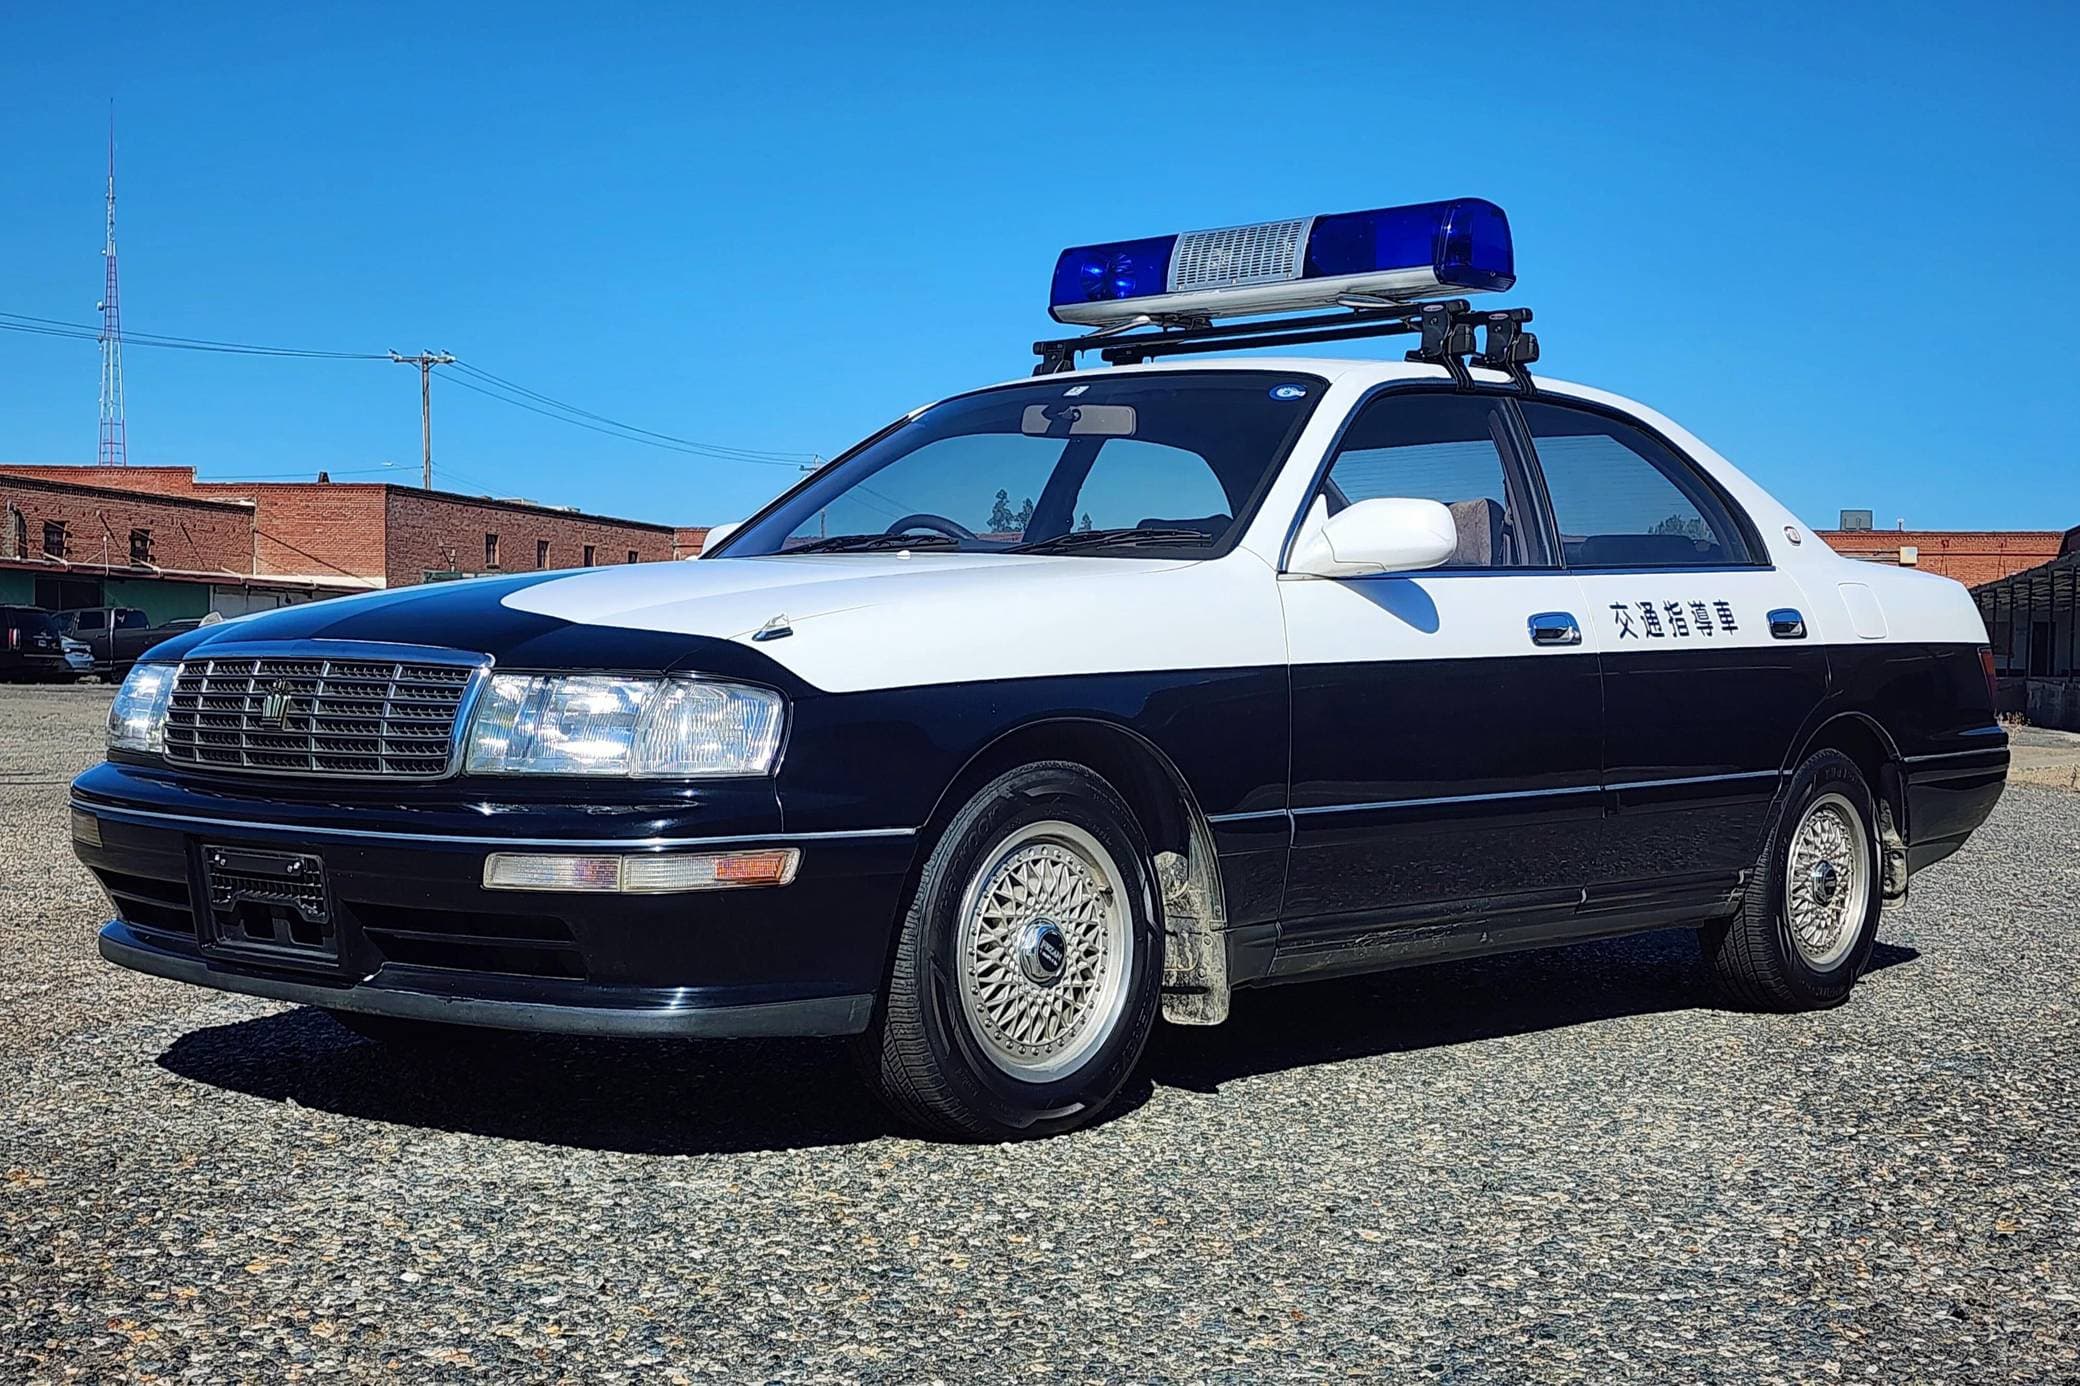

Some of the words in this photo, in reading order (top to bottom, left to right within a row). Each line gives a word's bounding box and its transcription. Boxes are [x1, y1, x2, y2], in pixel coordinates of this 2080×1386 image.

[1609, 599, 1739, 640] 交通指導車
